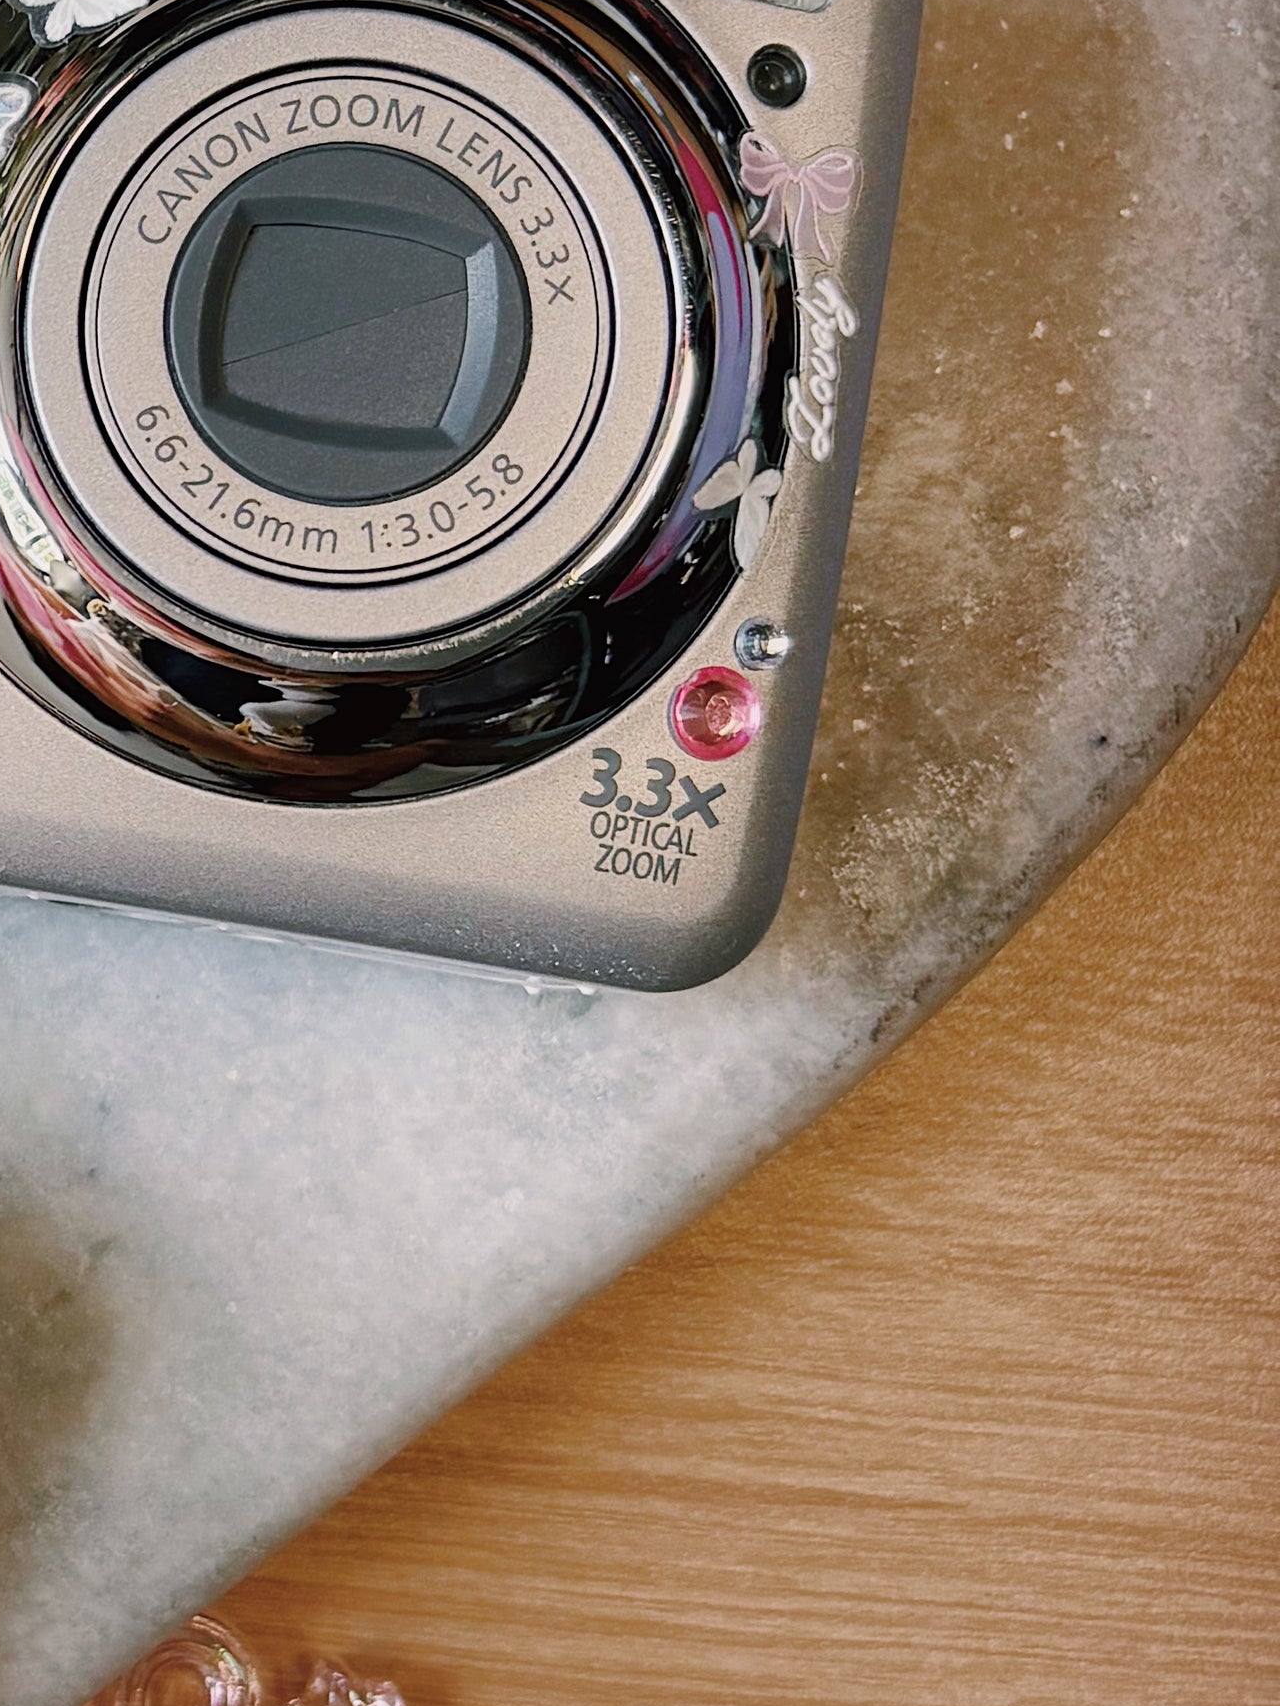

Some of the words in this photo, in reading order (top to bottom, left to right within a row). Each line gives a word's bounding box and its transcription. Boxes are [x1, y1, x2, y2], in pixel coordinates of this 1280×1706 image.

[137, 113, 271, 244] CANON
[280, 94, 425, 137] ZOOM
[435, 118, 533, 204] LENS
[788, 276, 858, 462] Lovely
[136, 405, 339, 554] 6.6-21.6mm
[361, 454, 524, 553] 1:3.0-5.8
[590, 811, 698, 856] OPTICAL
[594, 843, 681, 886] ZOOM
